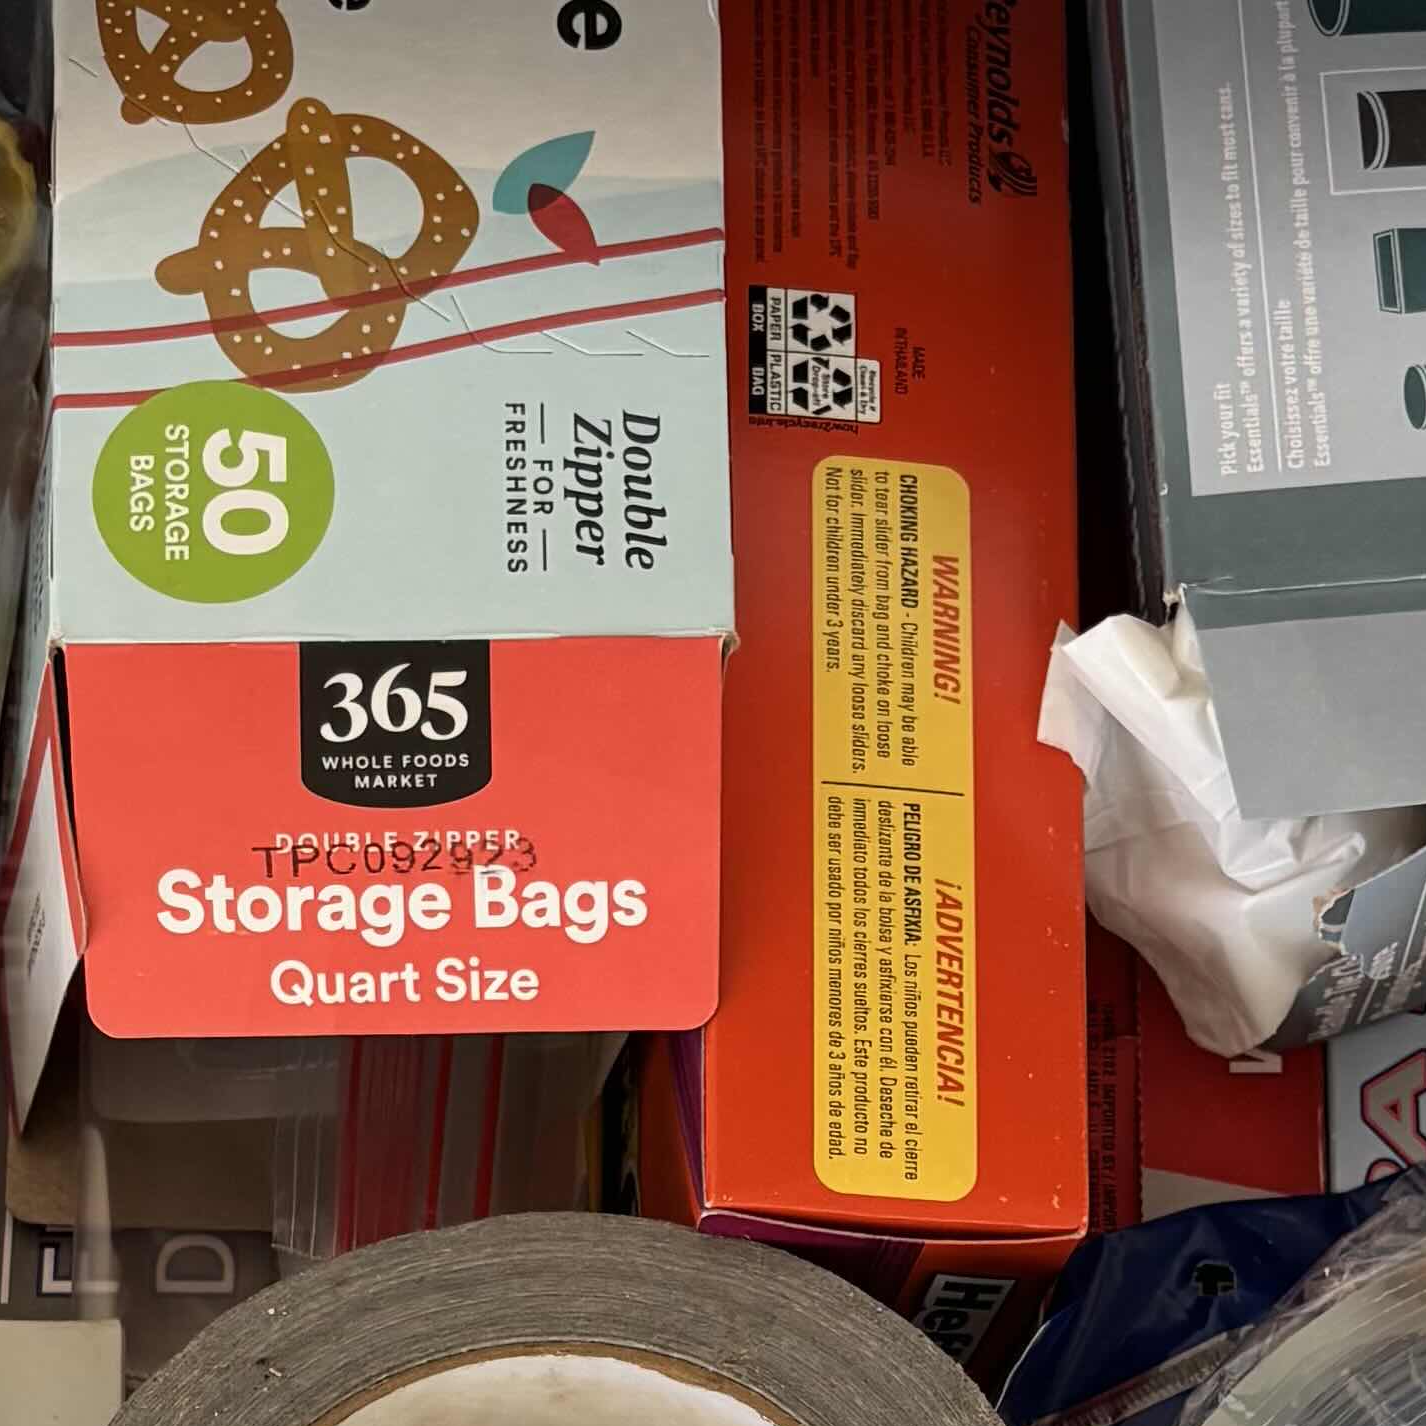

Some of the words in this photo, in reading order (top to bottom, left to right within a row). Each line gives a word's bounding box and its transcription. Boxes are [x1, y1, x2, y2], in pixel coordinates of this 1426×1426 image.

[751, 303, 765, 332] BOX
[751, 366, 765, 396] BAG
[128, 453, 156, 533] BAGS
[163, 422, 191, 563] STORAGE
[201, 427, 290, 557] 50
[503, 401, 529, 575] FRESHNESS
[531, 459, 556, 516] FOR
[563, 413, 614, 568] Zipper
[621, 408, 670, 573] Double
[825, 466, 844, 491] Not
[848, 468, 869, 509] slider.
[874, 469, 892, 485] to
[825, 494, 844, 515] for
[874, 486, 891, 516] tear
[898, 473, 919, 543] CHOKING
[825, 516, 844, 572] children
[846, 512, 869, 596] Immediately
[874, 518, 893, 557] slider
[874, 559, 894, 592] from
[899, 545, 920, 610] HAZARD
[825, 576, 844, 617] under
[870, 594, 892, 621] bag
[826, 619, 845, 628] 3
[849, 598, 870, 651] discard
[876, 623, 895, 650] and
[931, 554, 962, 705] WARNING!
[822, 630, 841, 673] years.
[847, 653, 866, 680] any
[899, 621, 919, 679] Children
[875, 653, 895, 696] choke
[320, 662, 470, 744] 365
[850, 681, 870, 721] loose
[875, 698, 891, 718] on
[896, 681, 915, 712] may
[875, 719, 894, 759] loose
[900, 714, 918, 733] be
[321, 754, 395, 771] WHOLE
[401, 753, 472, 769] FOODS
[851, 723, 871, 775] sliders.
[900, 736, 919, 767] able
[353, 773, 439, 790] MARKET
[275, 832, 397, 855] DOUBLE
[413, 830, 523, 853] ZIPPER
[156, 869, 453, 948] Storage
[472, 866, 650, 945] Bags
[270, 960, 421, 1007] Quart
[435, 956, 541, 1002] Size
[934, 878, 966, 1107] ¡ADVERTENCIA!
